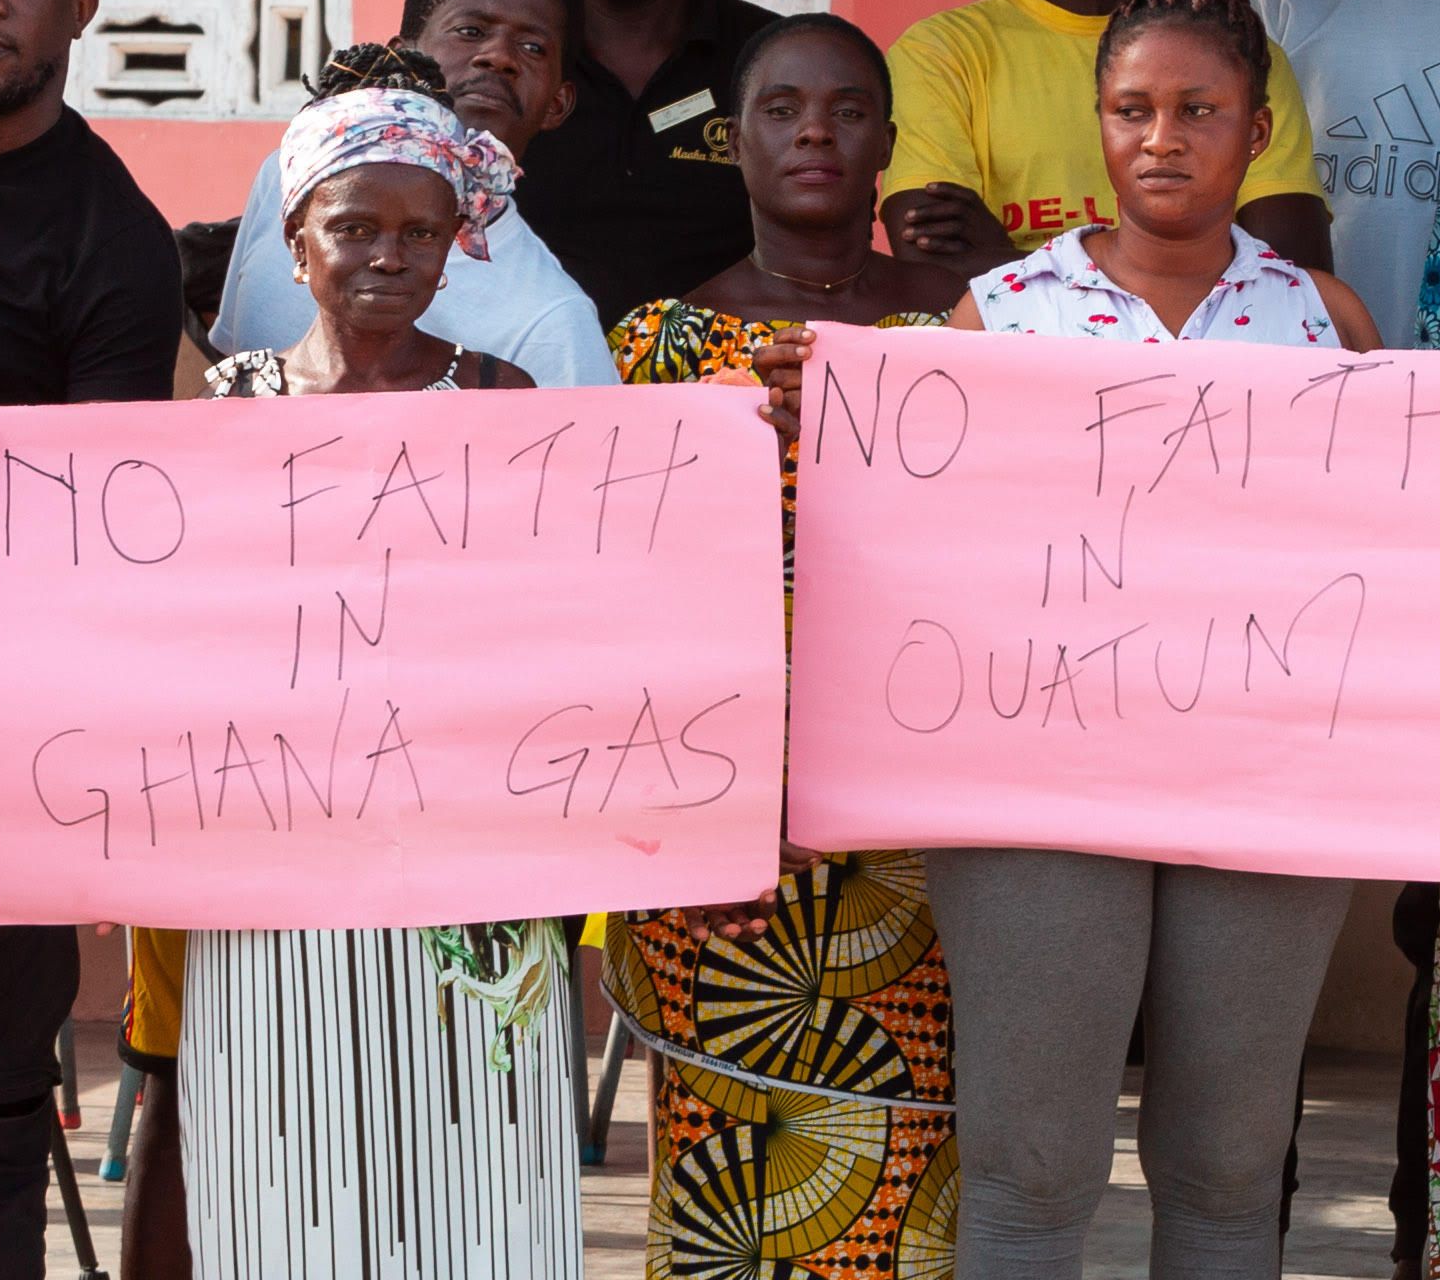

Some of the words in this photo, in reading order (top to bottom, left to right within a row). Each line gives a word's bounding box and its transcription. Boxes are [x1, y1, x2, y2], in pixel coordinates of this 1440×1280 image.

[1002, 196, 1120, 233] DE-L
[815, 353, 969, 479] NO
[4, 449, 185, 566] NO
[280, 419, 698, 567] FAITH
[1042, 485, 1136, 608] IN
[290, 548, 392, 689] IN
[32, 687, 425, 859] GHANA
[506, 687, 742, 818] GAS
